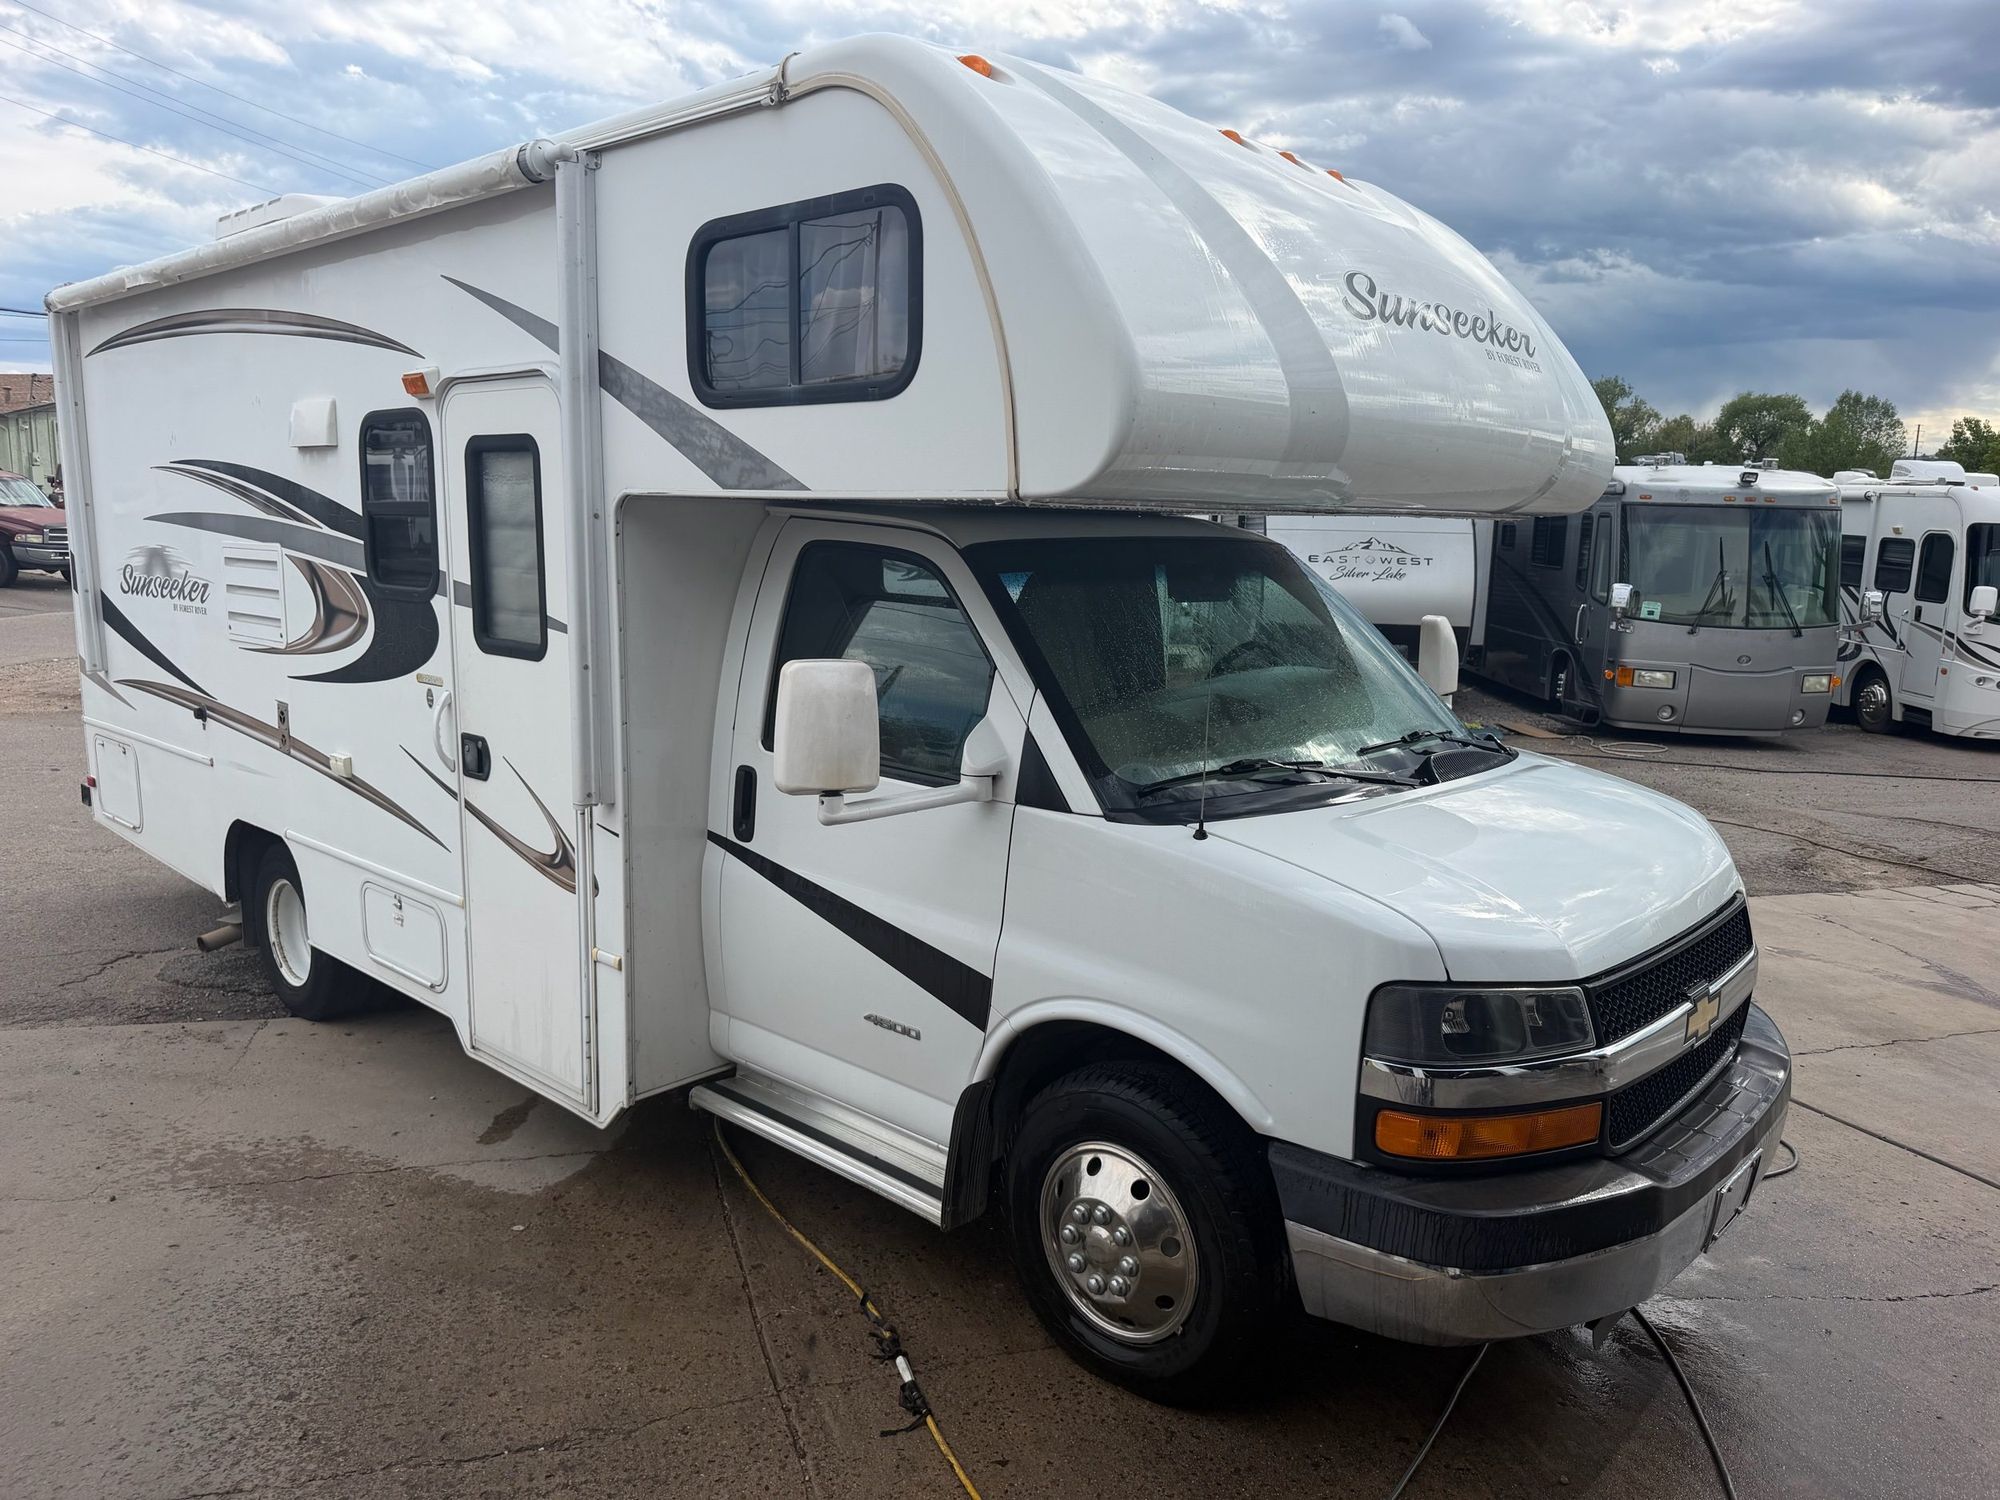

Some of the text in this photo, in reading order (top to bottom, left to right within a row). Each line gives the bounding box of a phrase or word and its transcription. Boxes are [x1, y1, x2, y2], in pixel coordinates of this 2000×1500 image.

[1343, 270, 1536, 358] Sunseeker
[1496, 351, 1522, 368] FOREST
[1522, 358, 1543, 374] RIVER
[1329, 565, 1407, 582] Silver Lake
[1380, 556, 1433, 566] WEST
[120, 563, 210, 604] Sunseeker
[863, 1013, 922, 1041] 4500
